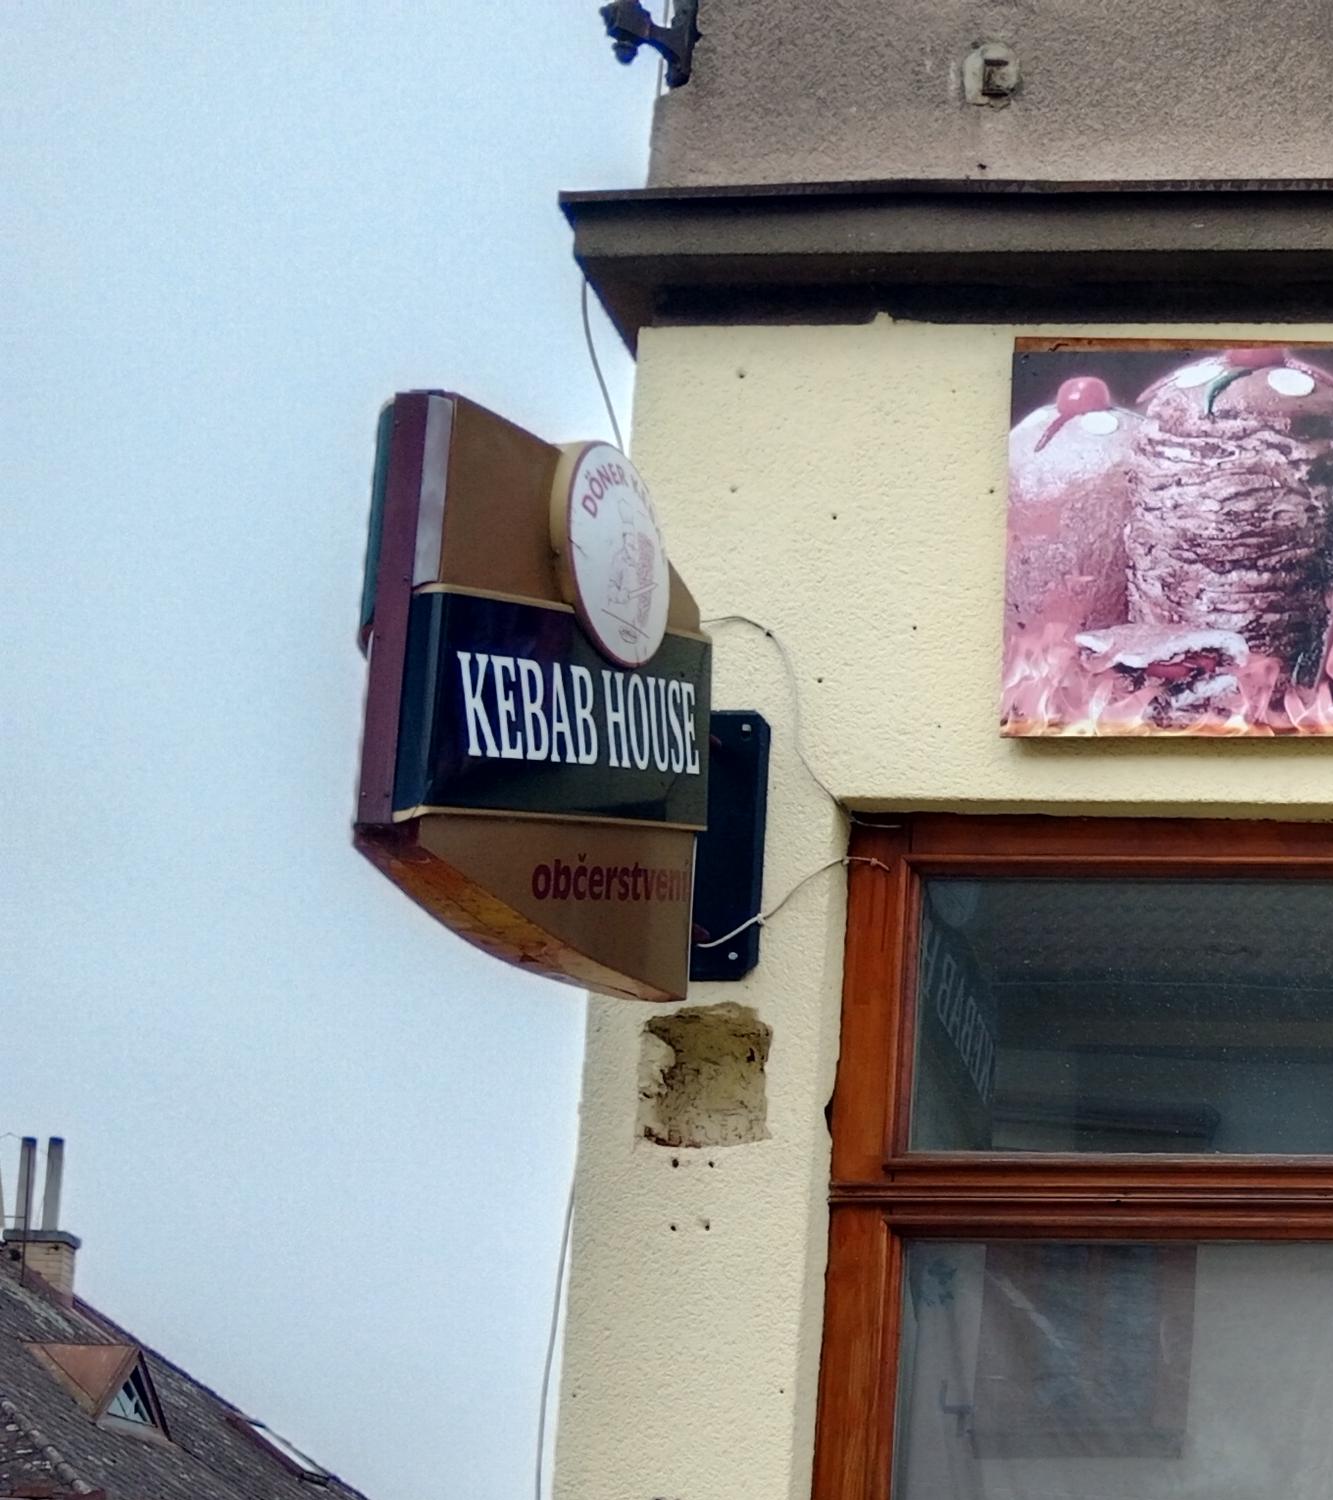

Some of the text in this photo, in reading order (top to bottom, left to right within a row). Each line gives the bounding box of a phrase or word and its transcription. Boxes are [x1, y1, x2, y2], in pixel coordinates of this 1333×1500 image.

[581, 462, 629, 519] DÖNER
[457, 651, 701, 776] KEBAB HOUSE
